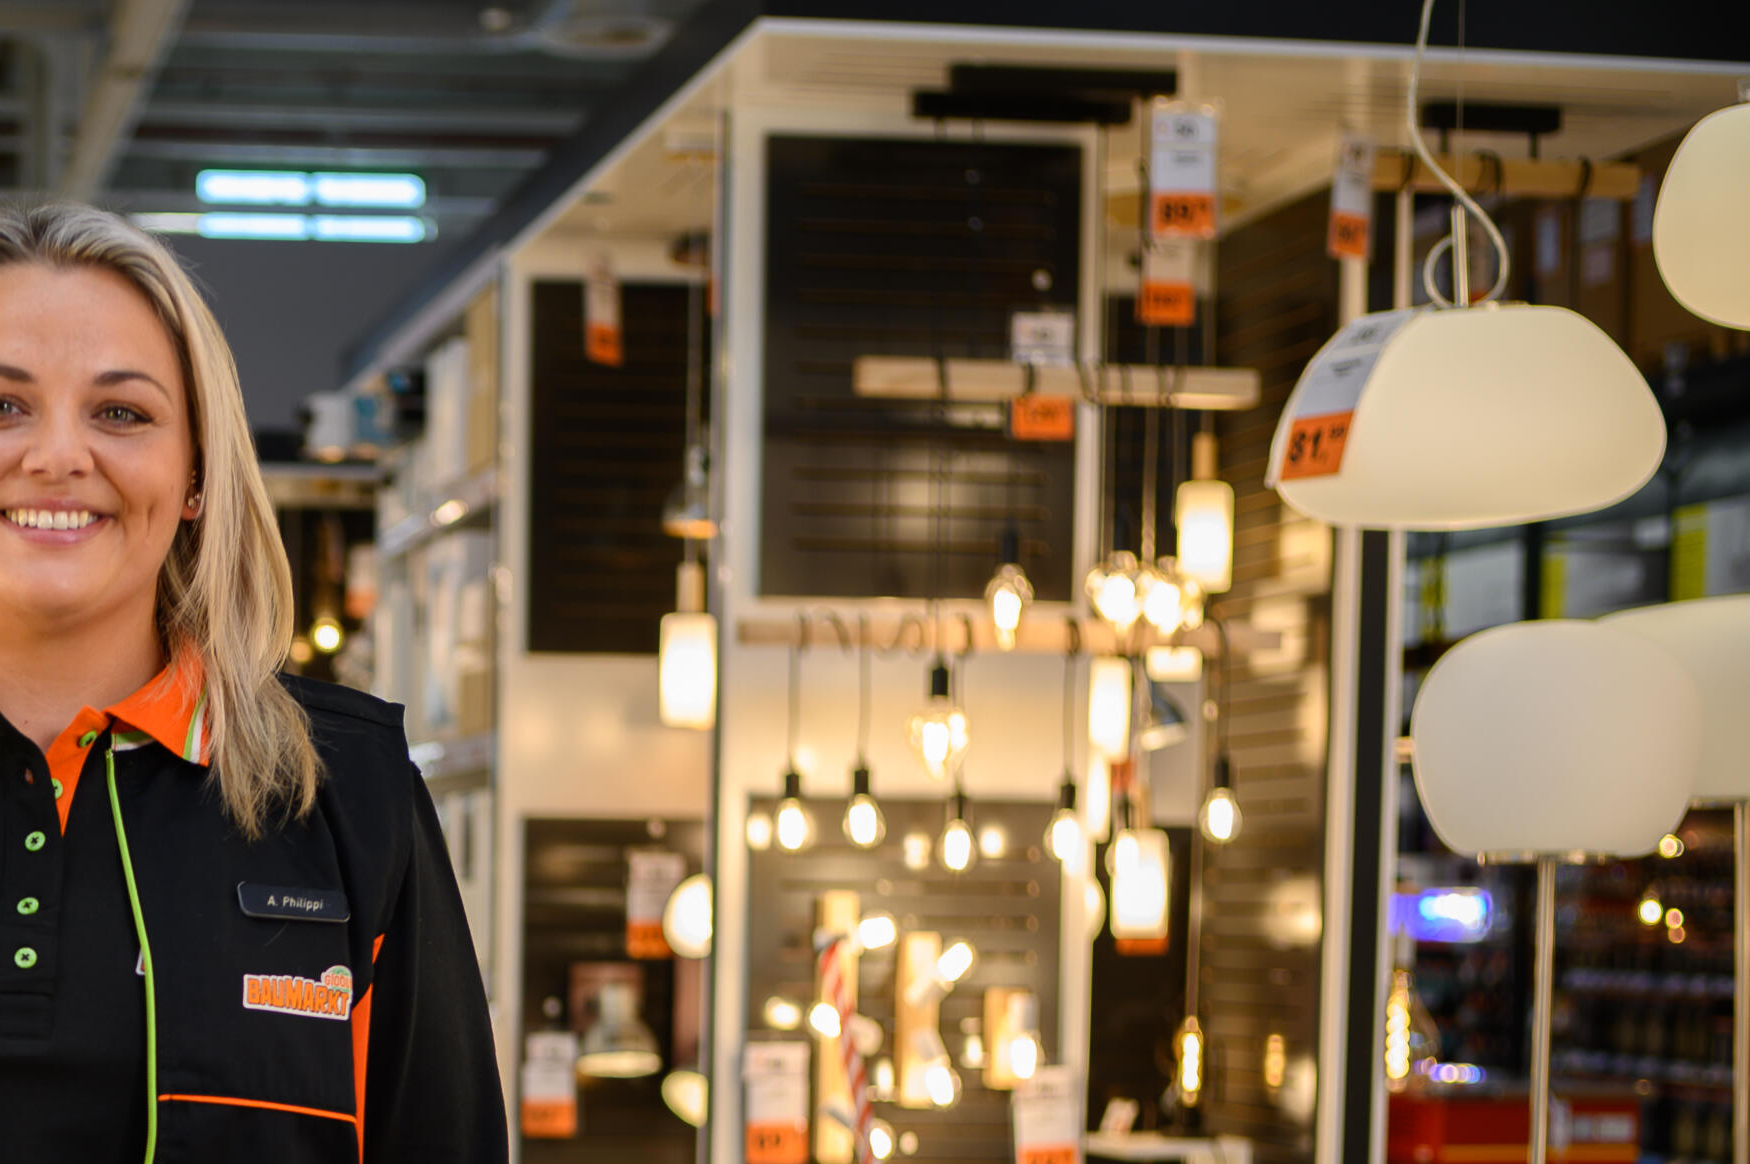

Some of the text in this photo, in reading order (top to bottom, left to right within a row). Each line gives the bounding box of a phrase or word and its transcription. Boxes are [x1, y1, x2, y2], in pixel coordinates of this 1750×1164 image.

[267, 894, 324, 911] A. Philippi
[247, 977, 350, 1016] BAUMARKT
